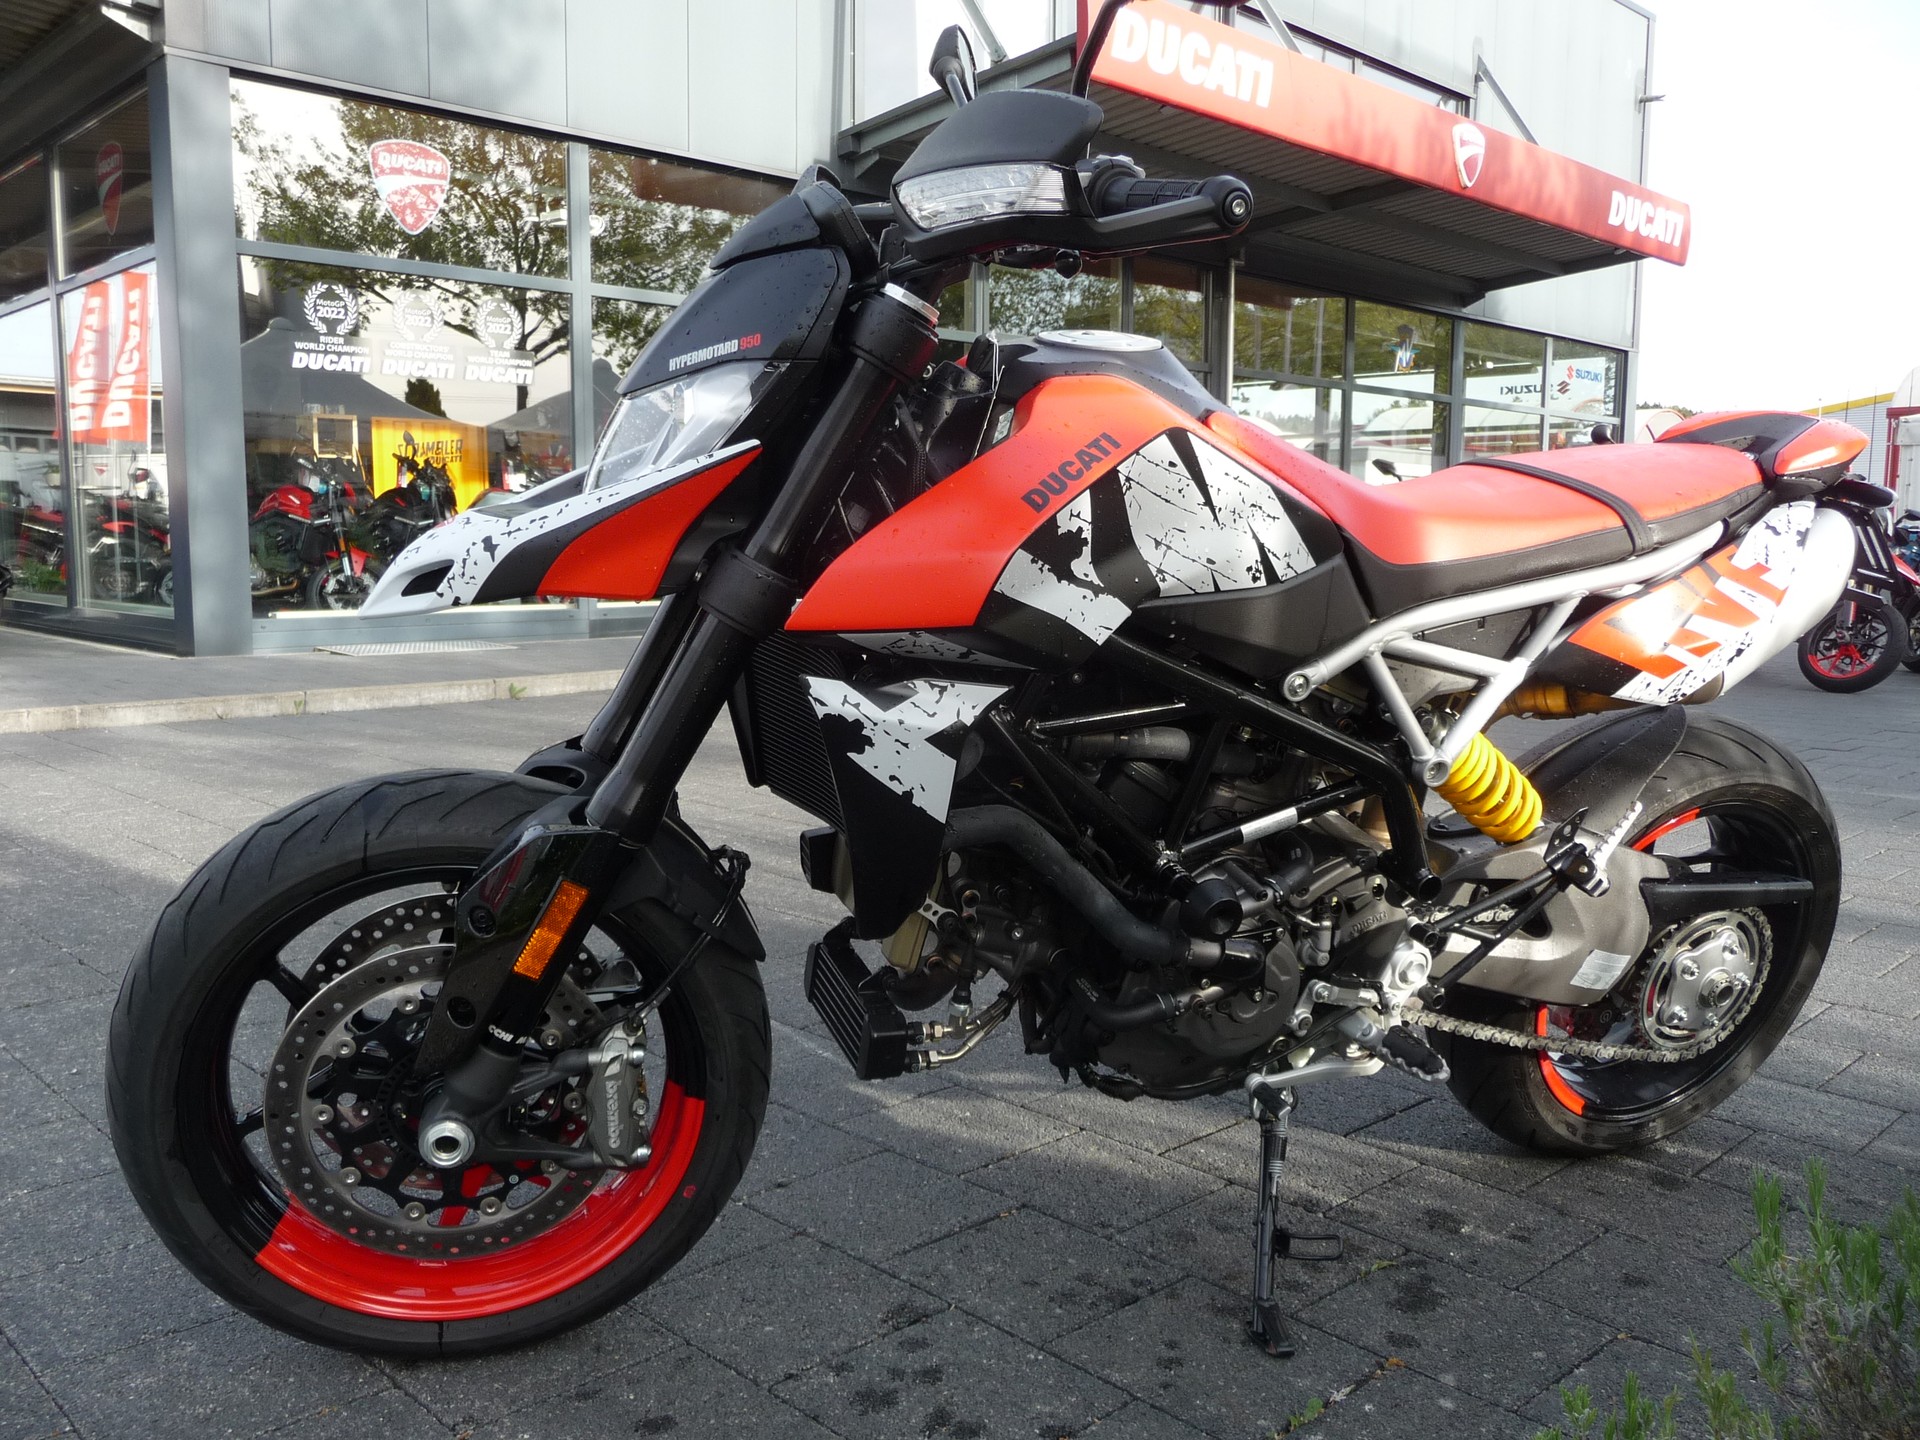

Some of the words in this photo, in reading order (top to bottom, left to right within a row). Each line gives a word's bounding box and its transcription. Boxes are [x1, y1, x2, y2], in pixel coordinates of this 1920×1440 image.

[1111, 7, 1274, 108] DUCATI
[378, 151, 443, 174] DUCATI
[1608, 190, 1684, 247] DUCATI
[316, 299, 345, 307] MotoGP
[316, 306, 346, 319] 2022
[404, 315, 432, 327] 2022
[486, 323, 512, 335] 2022
[294, 341, 326, 351] WORLD
[326, 344, 370, 354] CHAMPION
[319, 336, 345, 345] RIDER
[467, 355, 494, 364] WORLD
[494, 357, 533, 368] CHAMPION
[489, 350, 511, 358] TEAM
[669, 339, 739, 372] HYPERMOTARD
[740, 333, 761, 350] 950
[292, 352, 372, 373] DUCATI
[381, 358, 456, 379] DUCATI
[465, 364, 534, 385] DUCATI
[1575, 368, 1603, 383] SUZUKI
[1021, 432, 1122, 513] DUCATI
[605, 1079, 624, 1149] brembo
